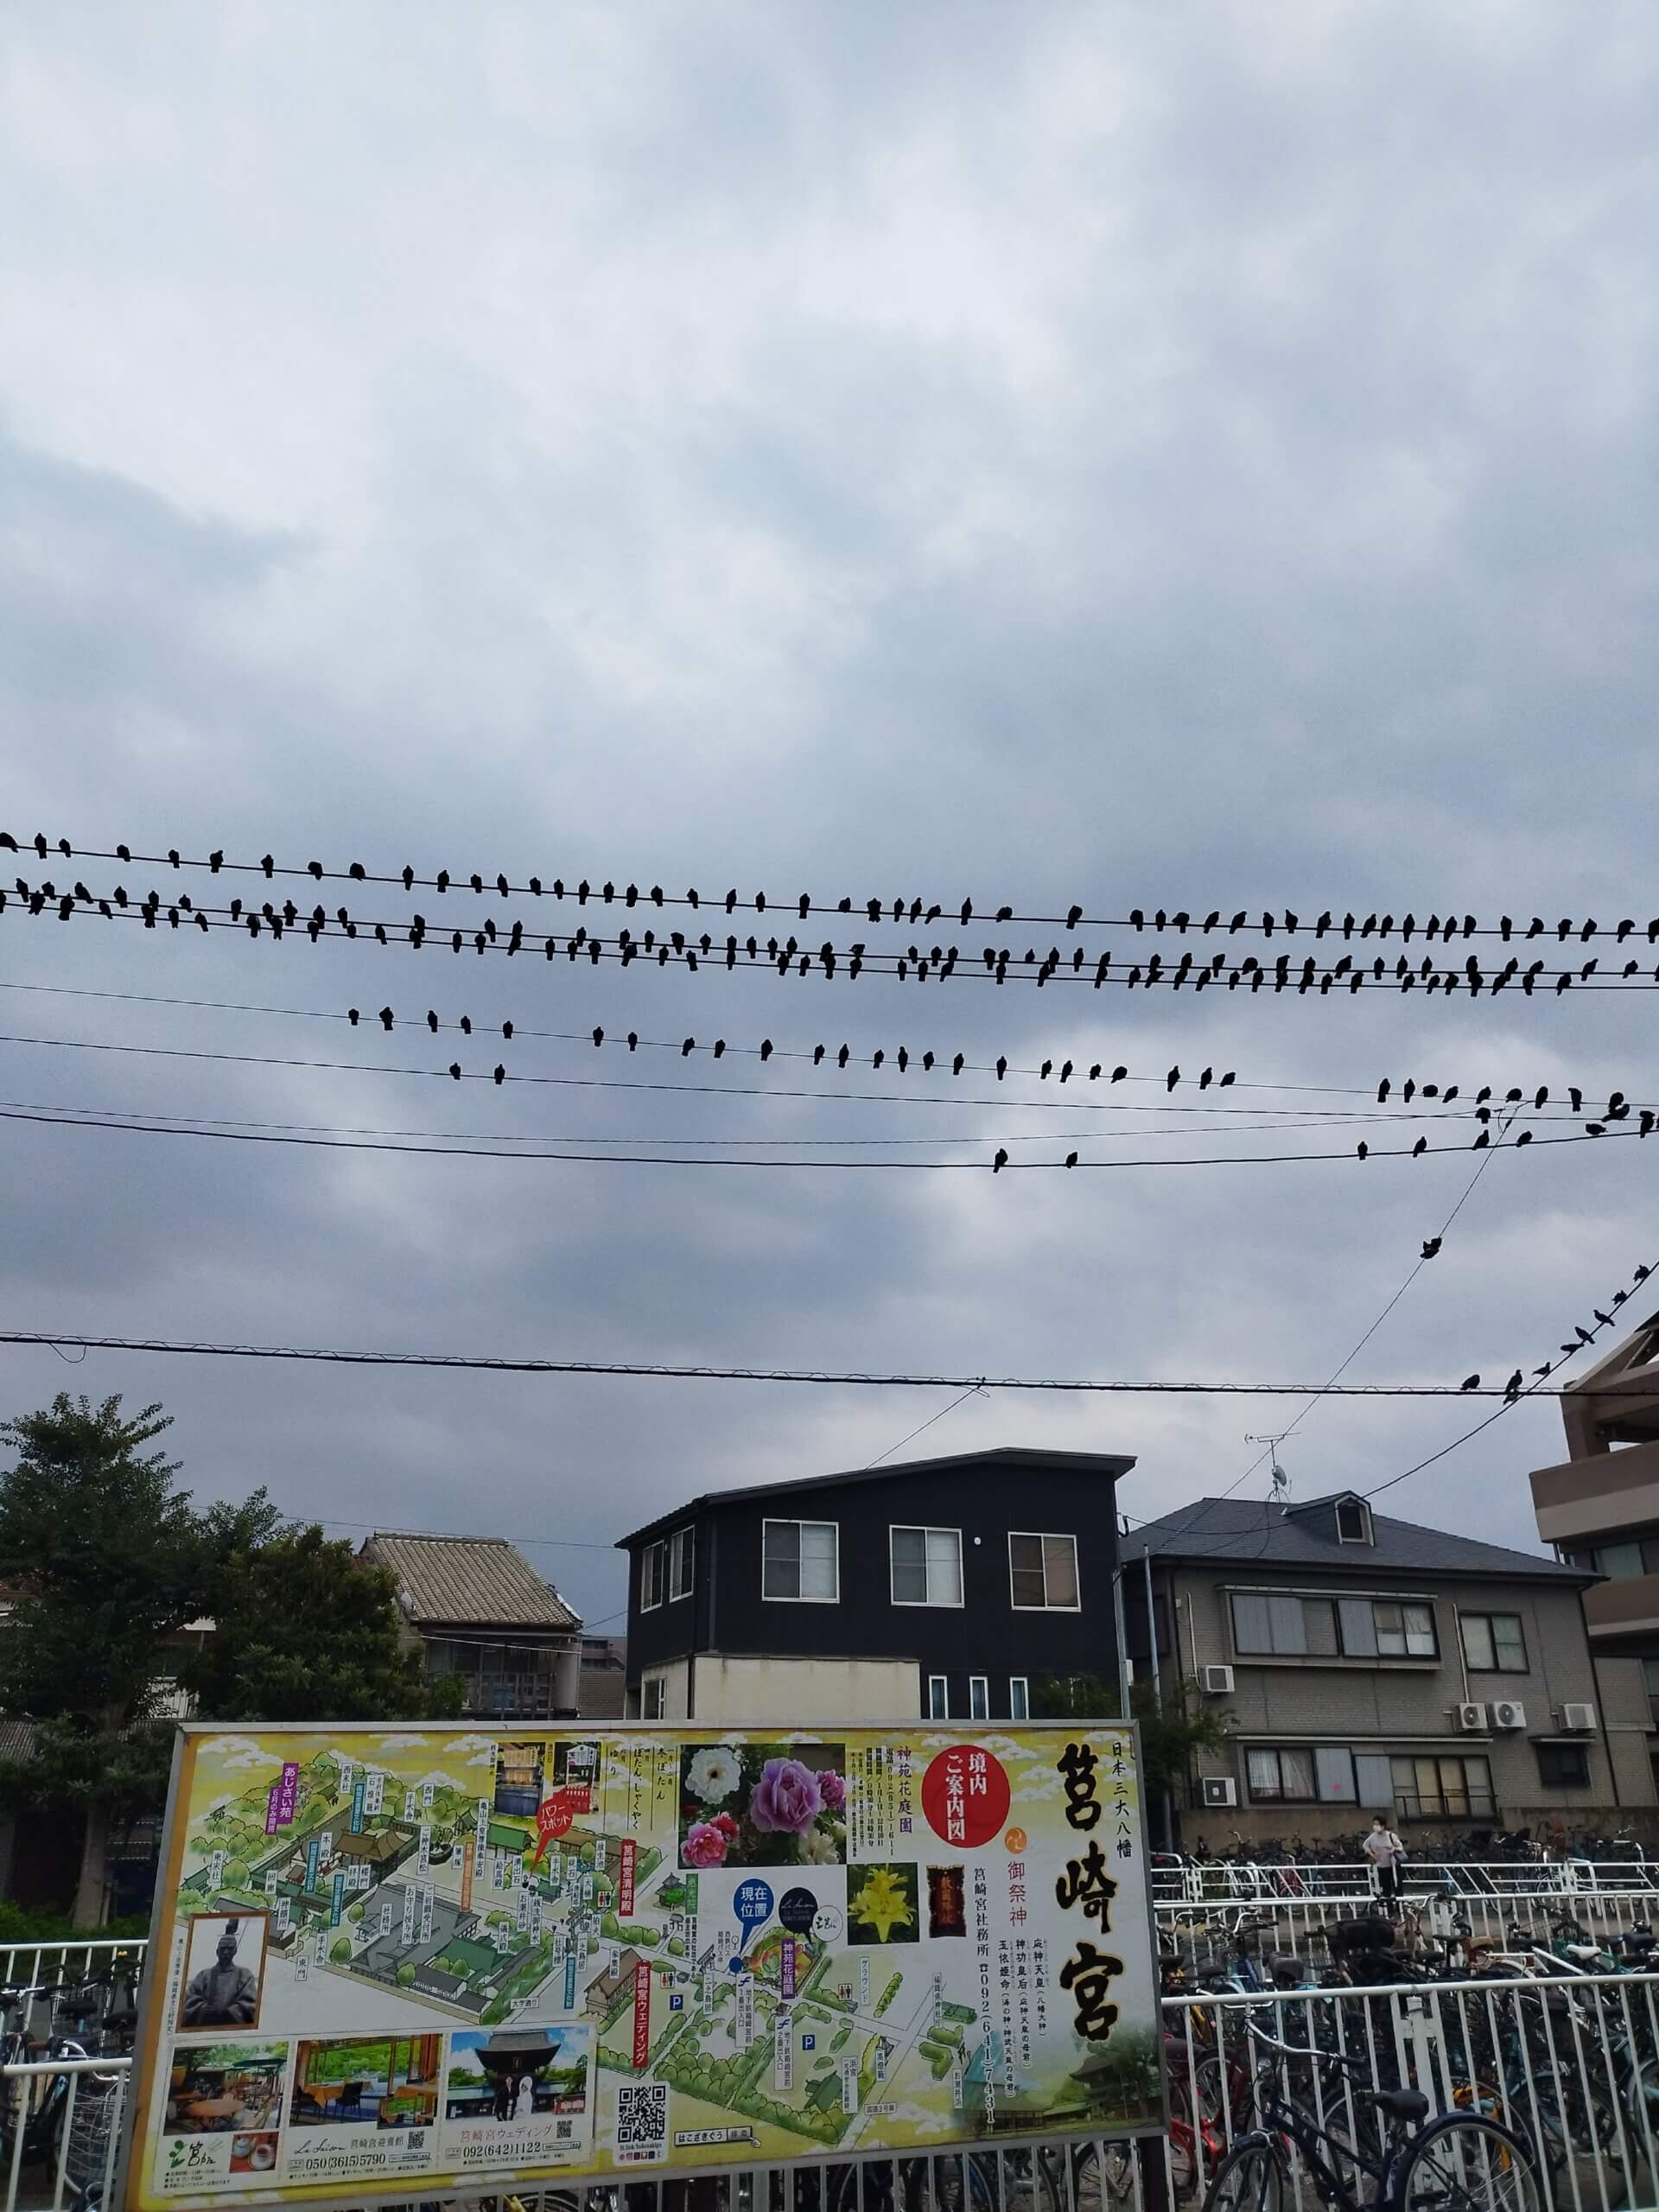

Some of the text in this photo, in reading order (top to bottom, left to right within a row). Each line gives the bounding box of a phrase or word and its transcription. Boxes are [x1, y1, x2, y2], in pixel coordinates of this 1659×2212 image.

[610, 1751, 619, 1776] ゆり
[657, 1747, 668, 1800] 冬ぼたん
[969, 1752, 987, 1796] 境内
[279, 1767, 296, 1818] あじさい苑
[425, 1786, 433, 1806] 西門
[632, 1747, 642, 1830] ぼたん、しゃくやく
[898, 1745, 913, 1834] 神苑花庭園
[945, 1754, 965, 1840] ご案内図
[1112, 1742, 1133, 1859] 日本三大八幡
[540, 1815, 570, 1833] スポット
[541, 1805, 566, 1820] パワー
[321, 1834, 331, 1858] 本殿
[741, 1886, 768, 1901] 現在
[1007, 1860, 1027, 1927] 御祭神
[403, 1887, 416, 1943] お守り授与所
[741, 1903, 768, 1918] 位置
[974, 1867, 990, 1957] 筥崎宮社務所
[296, 1957, 307, 1980] 東門
[782, 1943, 794, 1995] 神苑花庭園
[512, 1999, 538, 2010] 大学通り
[463, 2142, 541, 2158] 092(642)1122
[678, 2132, 722, 2143] はこざきぐう
[306, 2153, 386, 2171] 050(3615)5790
